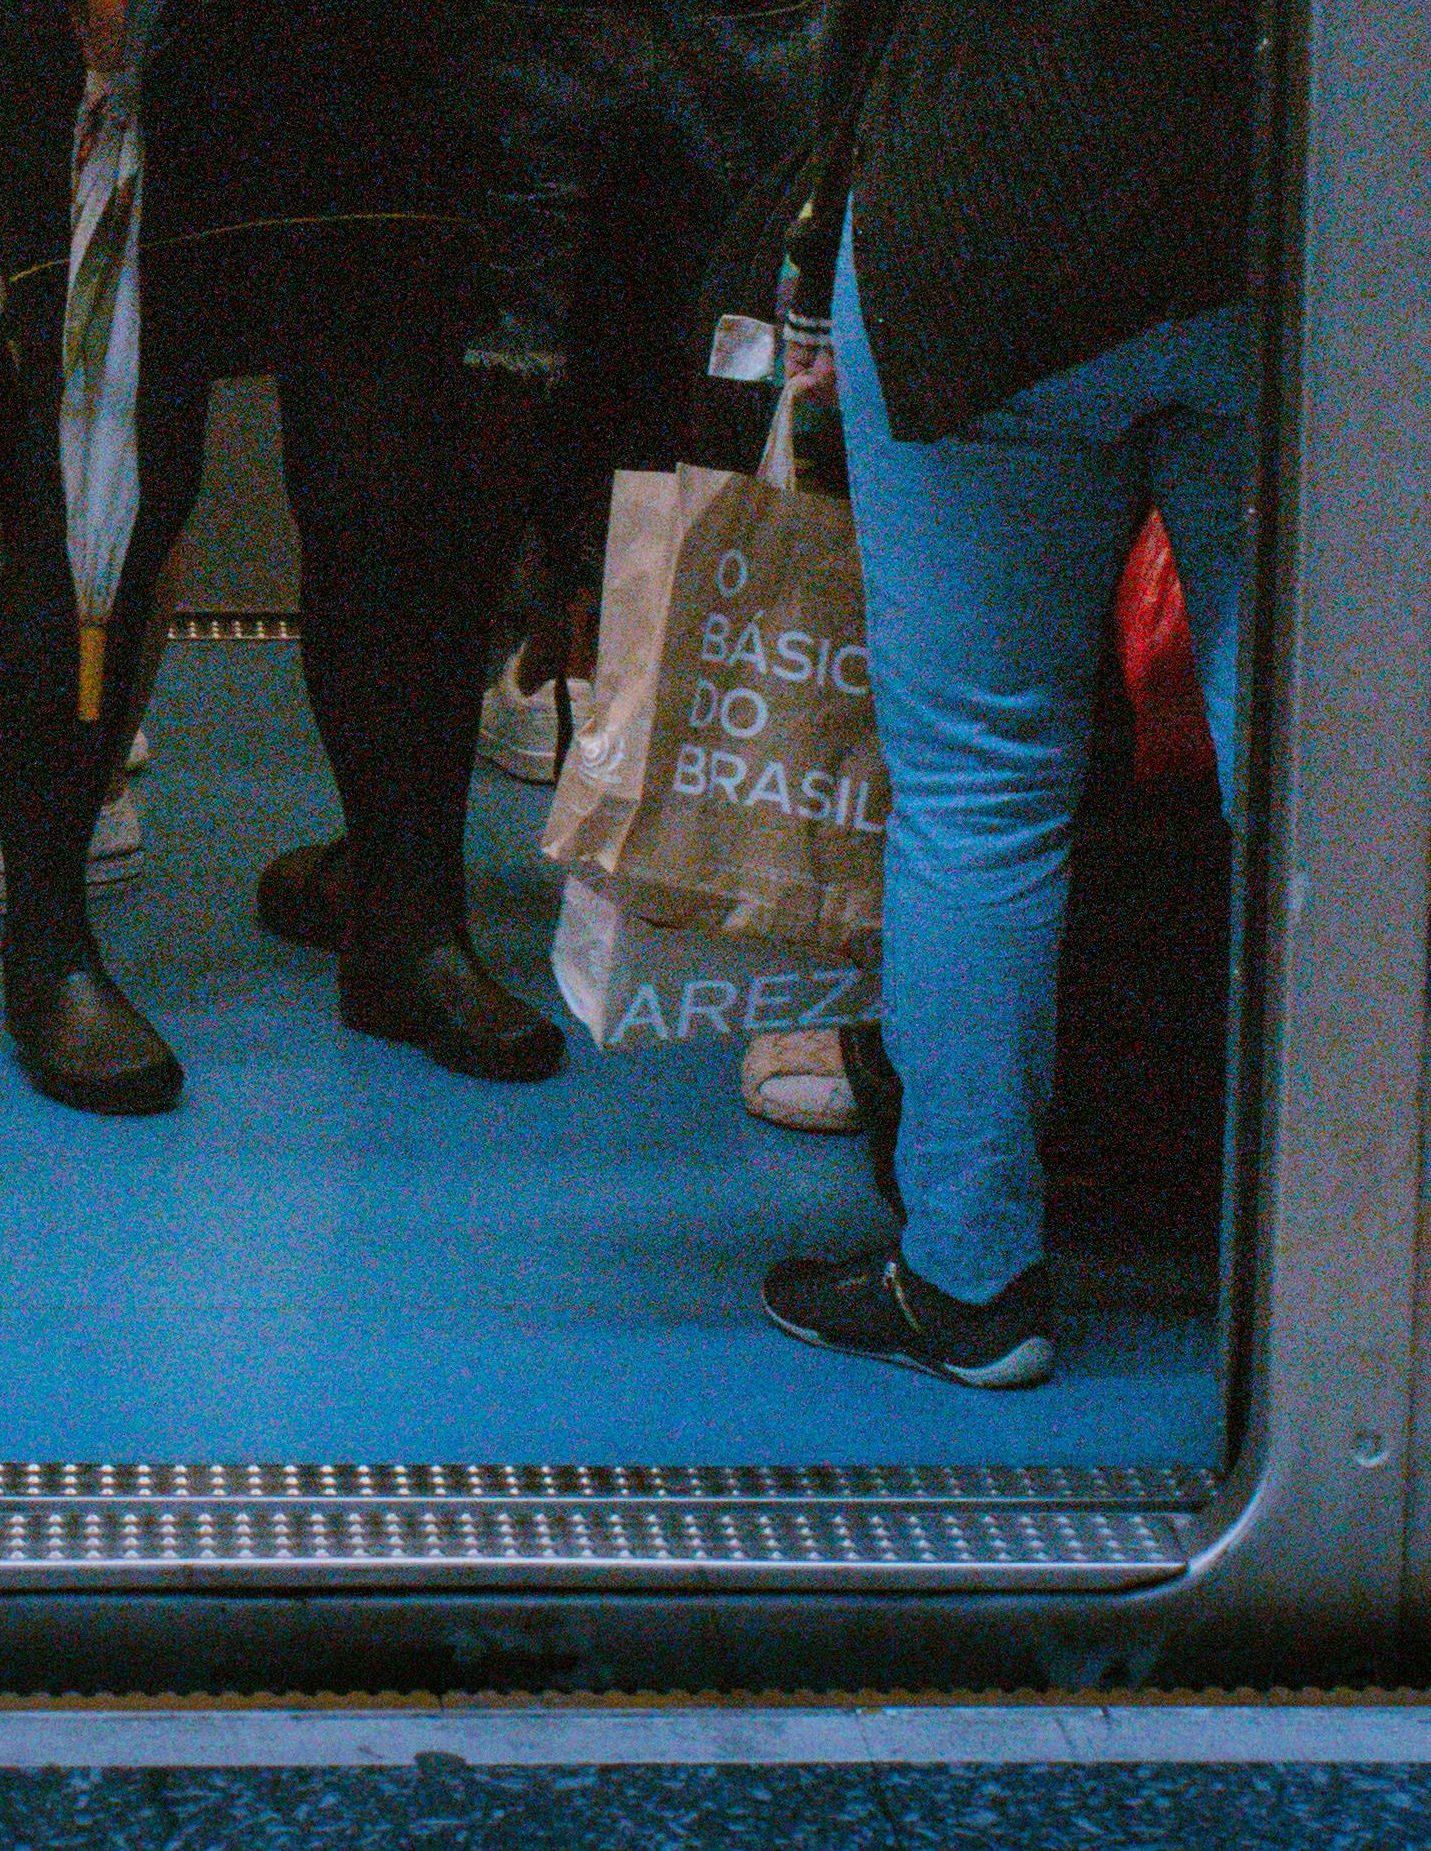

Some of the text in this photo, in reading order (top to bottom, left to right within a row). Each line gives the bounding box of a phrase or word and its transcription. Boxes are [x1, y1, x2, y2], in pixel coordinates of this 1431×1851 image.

[716, 548, 748, 598] O
[700, 609, 870, 696] BÁSIC
[688, 677, 769, 739] DO
[671, 743, 887, 833] BRASIL
[606, 967, 874, 1044] AREZ
